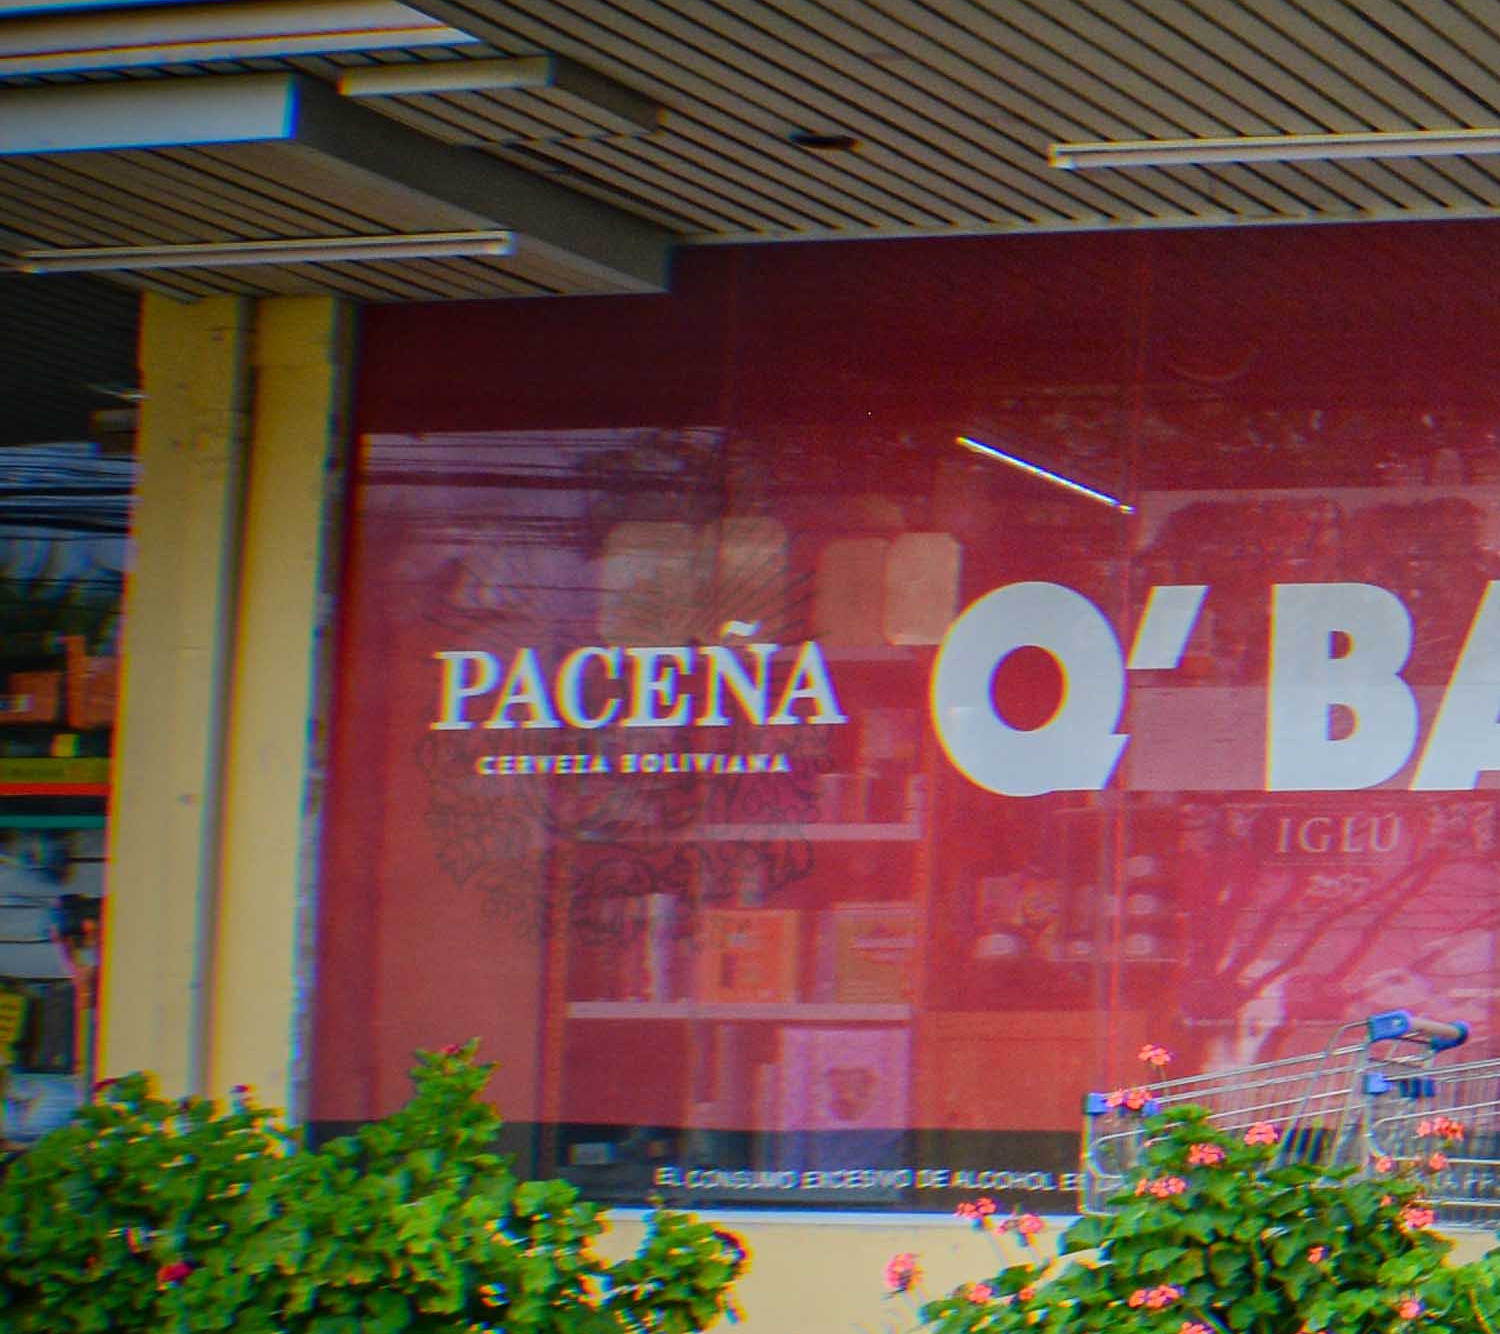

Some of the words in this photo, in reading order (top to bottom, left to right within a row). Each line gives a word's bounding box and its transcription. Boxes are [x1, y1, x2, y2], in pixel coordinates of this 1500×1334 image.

[430, 620, 849, 731] PACEÑA
[476, 754, 611, 776] CERVEZA
[619, 753, 793, 775] BOLIVIANA
[656, 1166, 684, 1187] EL
[916, 1168, 950, 1190] DE
[951, 1169, 1057, 1191] ALCOHOL
